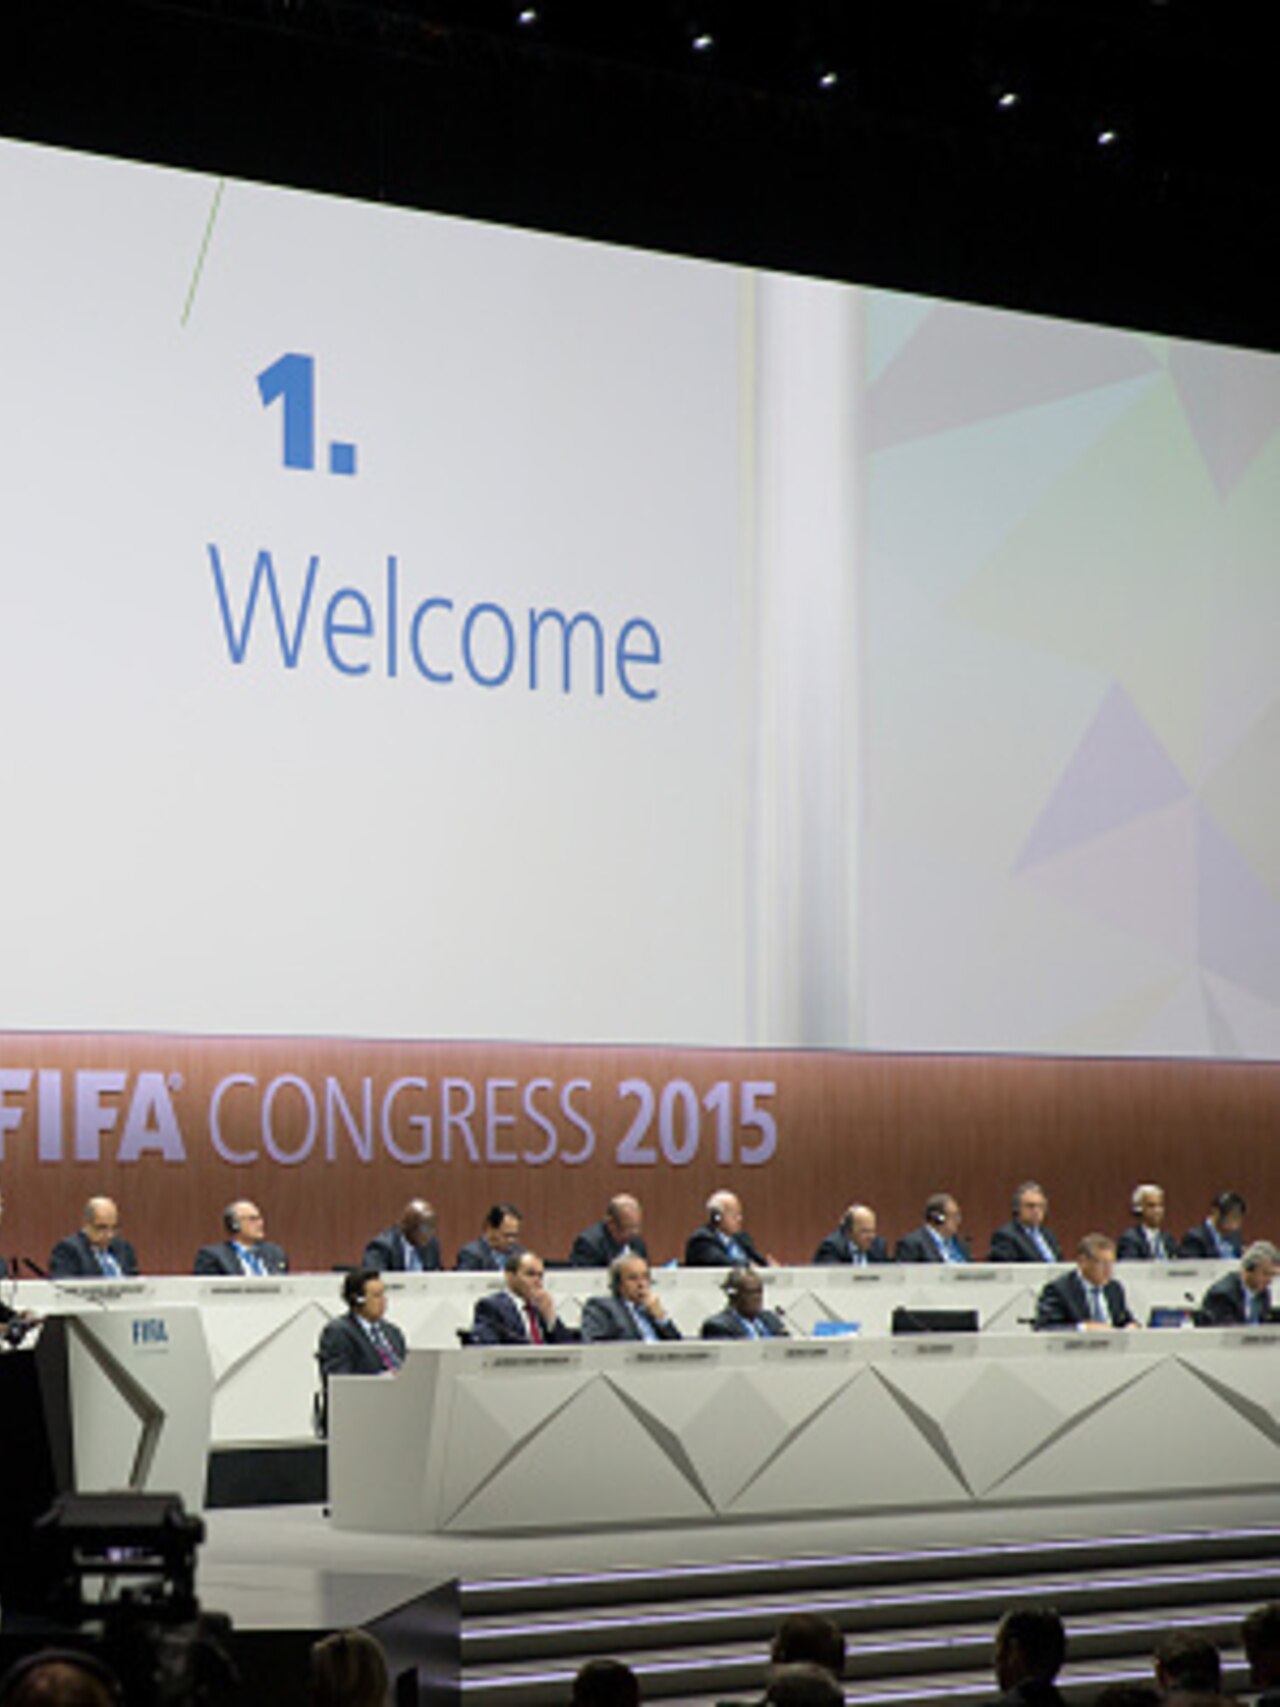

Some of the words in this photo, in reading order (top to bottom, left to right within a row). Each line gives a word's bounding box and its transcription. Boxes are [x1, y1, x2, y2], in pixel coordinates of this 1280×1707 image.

[255, 352, 357, 476] 1.
[207, 543, 662, 701] Welcome
[209, 1073, 596, 1165] CONGRESS
[616, 1078, 778, 1166] 2015
